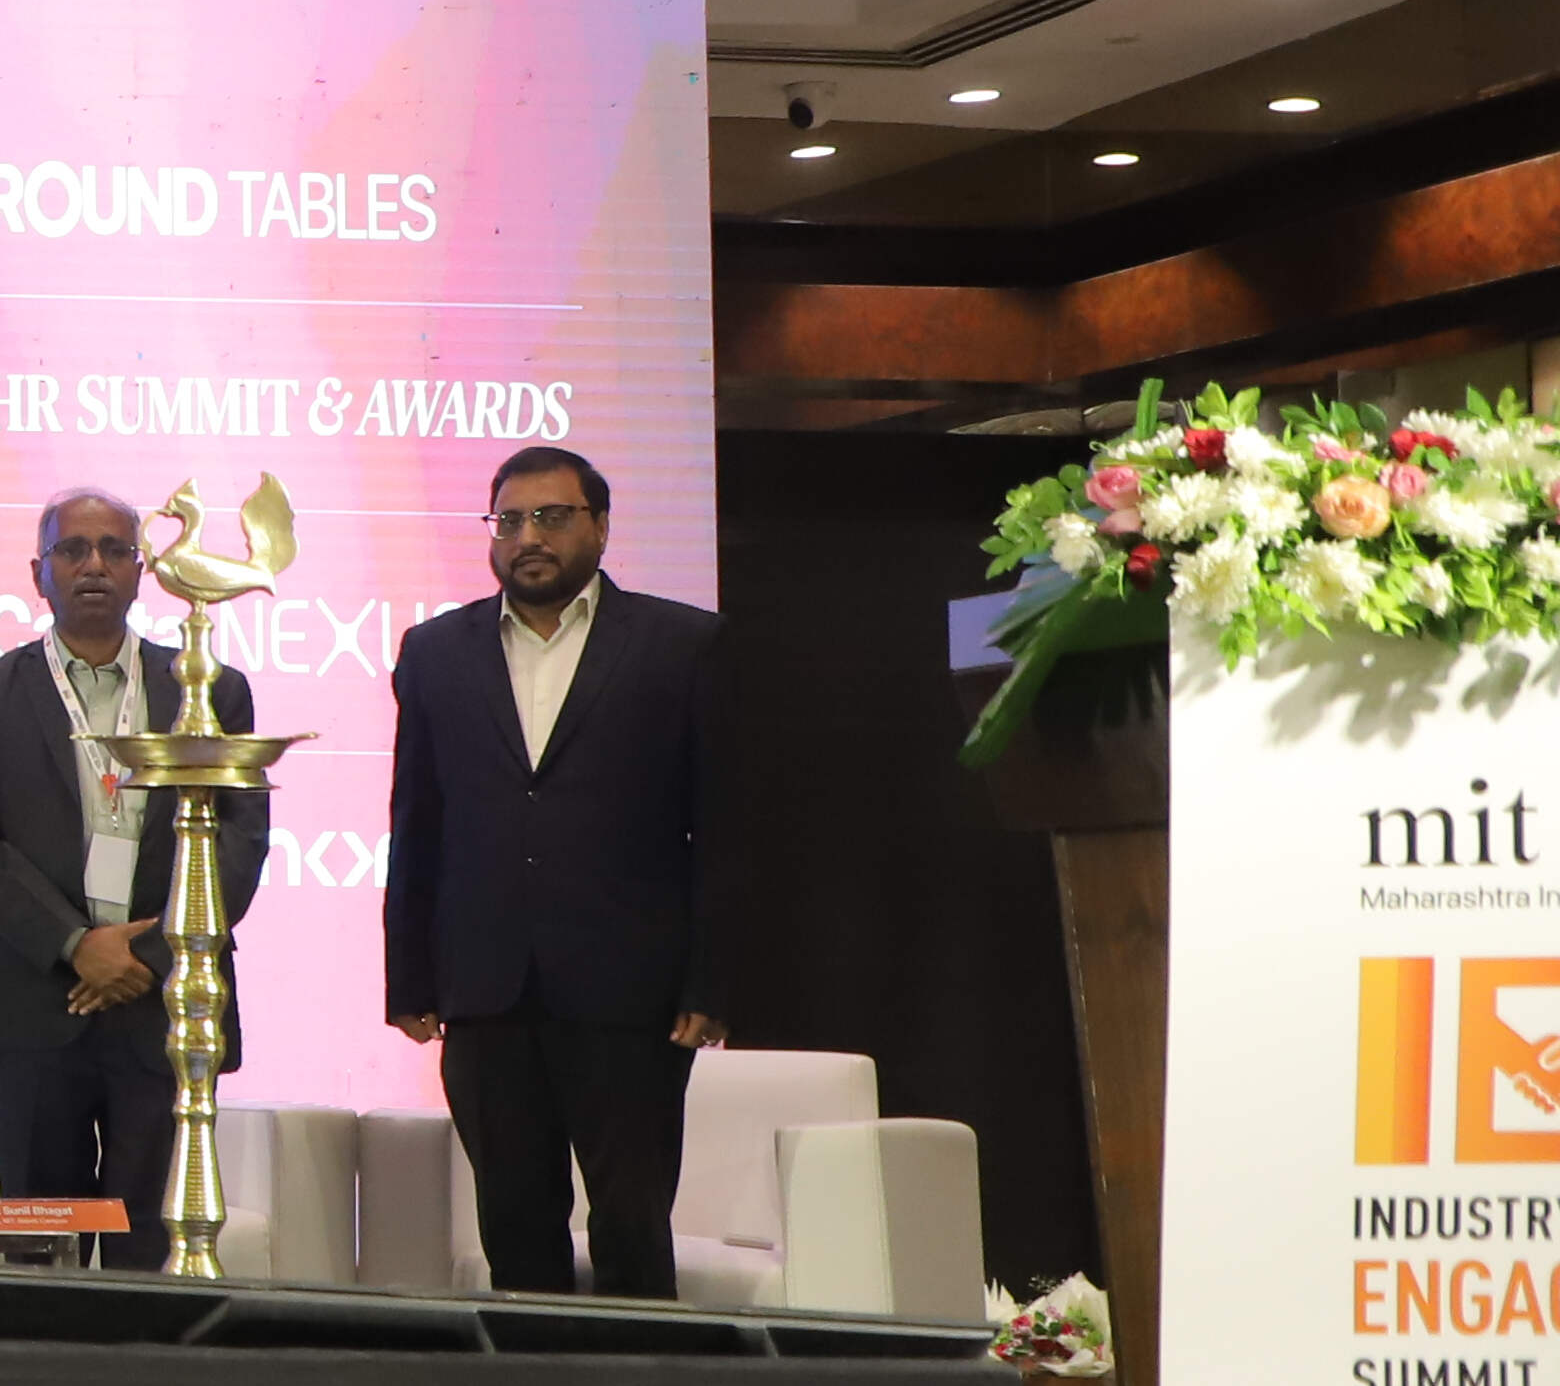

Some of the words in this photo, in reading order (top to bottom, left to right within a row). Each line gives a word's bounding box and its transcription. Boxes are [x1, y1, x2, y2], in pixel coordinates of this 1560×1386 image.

[228, 170, 437, 242] TABLES
[76, 374, 299, 437] SUMMIT
[307, 377, 355, 436] &
[356, 379, 573, 441] AWARDS
[1360, 777, 1540, 868] mit
[1360, 885, 1531, 910] Maharashtra
[1353, 1196, 1560, 1240] INDUSTR
[1353, 1259, 1560, 1336] ENGA
